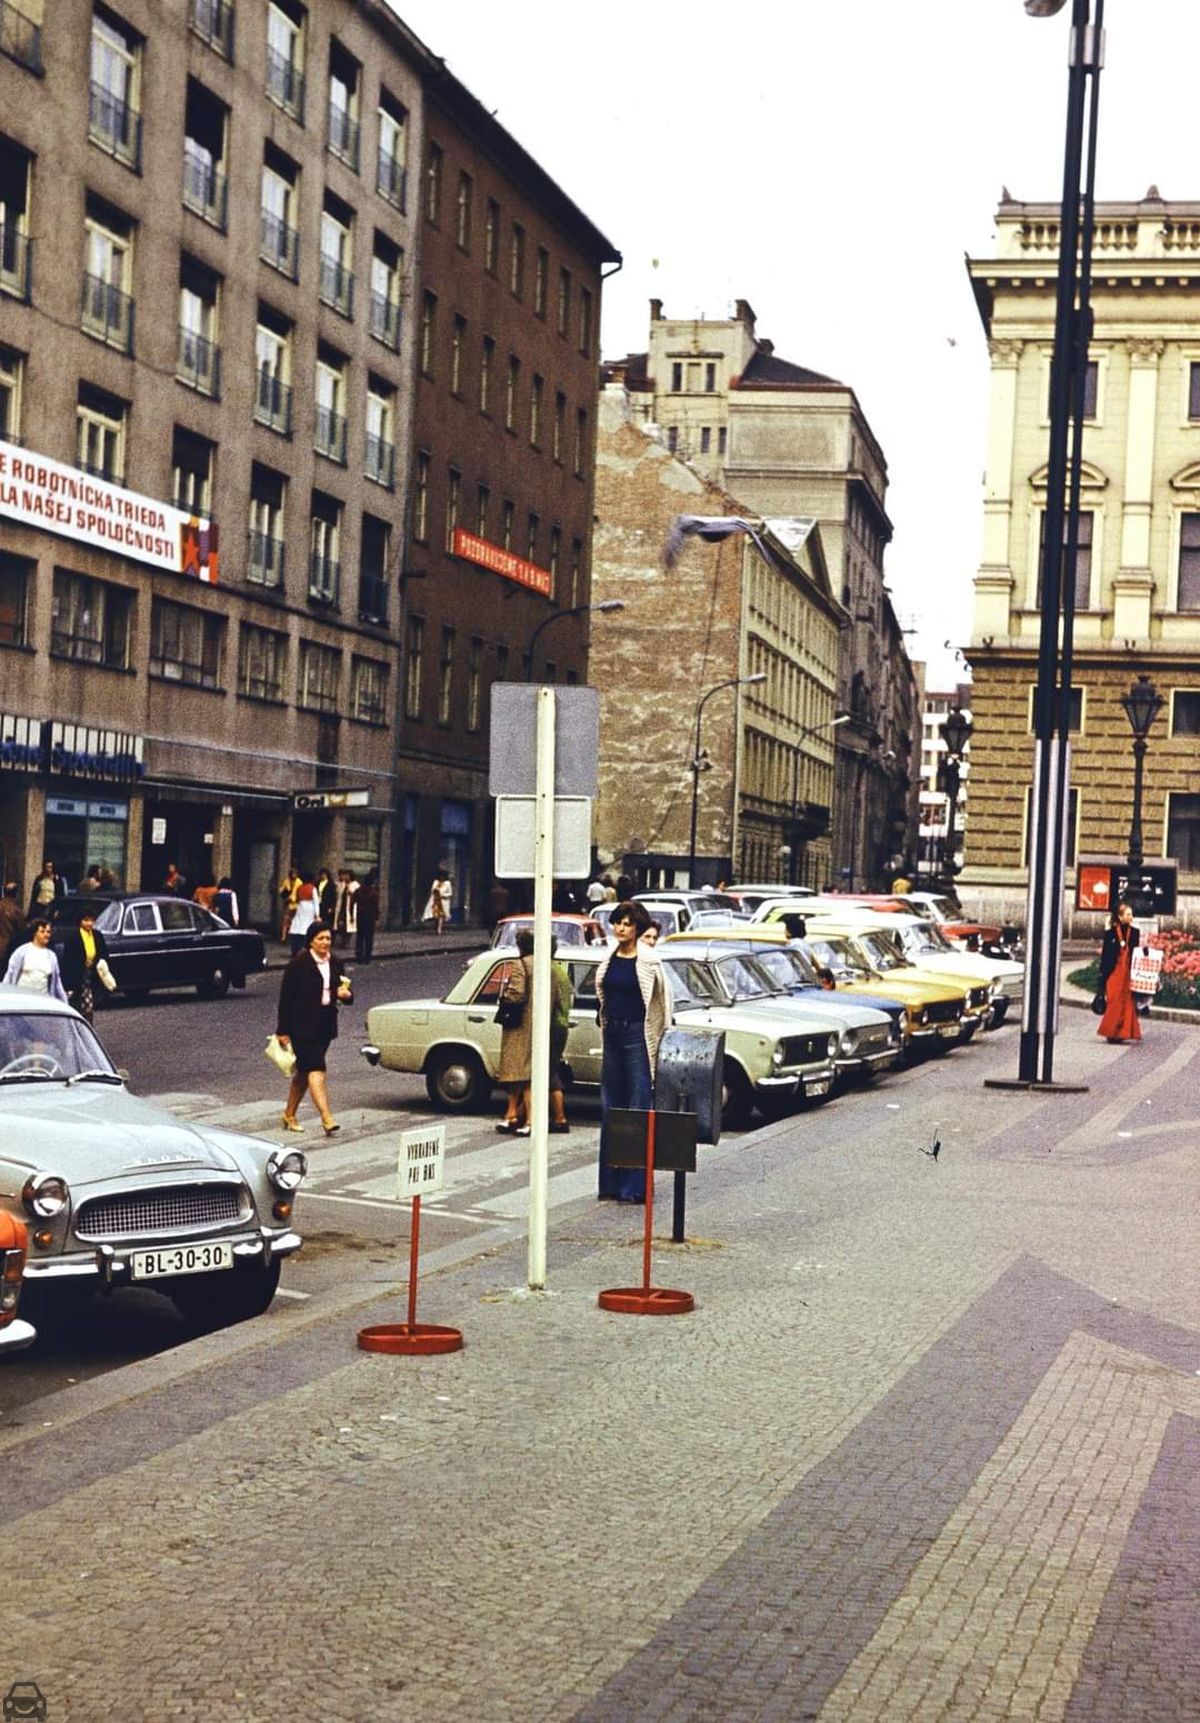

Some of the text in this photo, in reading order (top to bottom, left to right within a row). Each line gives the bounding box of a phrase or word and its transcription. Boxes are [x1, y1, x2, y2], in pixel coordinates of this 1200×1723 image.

[12, 458, 114, 513] ROBOTNÍCKA
[115, 498, 166, 532] TRIEDA
[22, 490, 73, 525] NAŠEJ
[76, 509, 175, 561] SPOLOČNOSTI
[144, 1246, 223, 1275] BL-30-30
